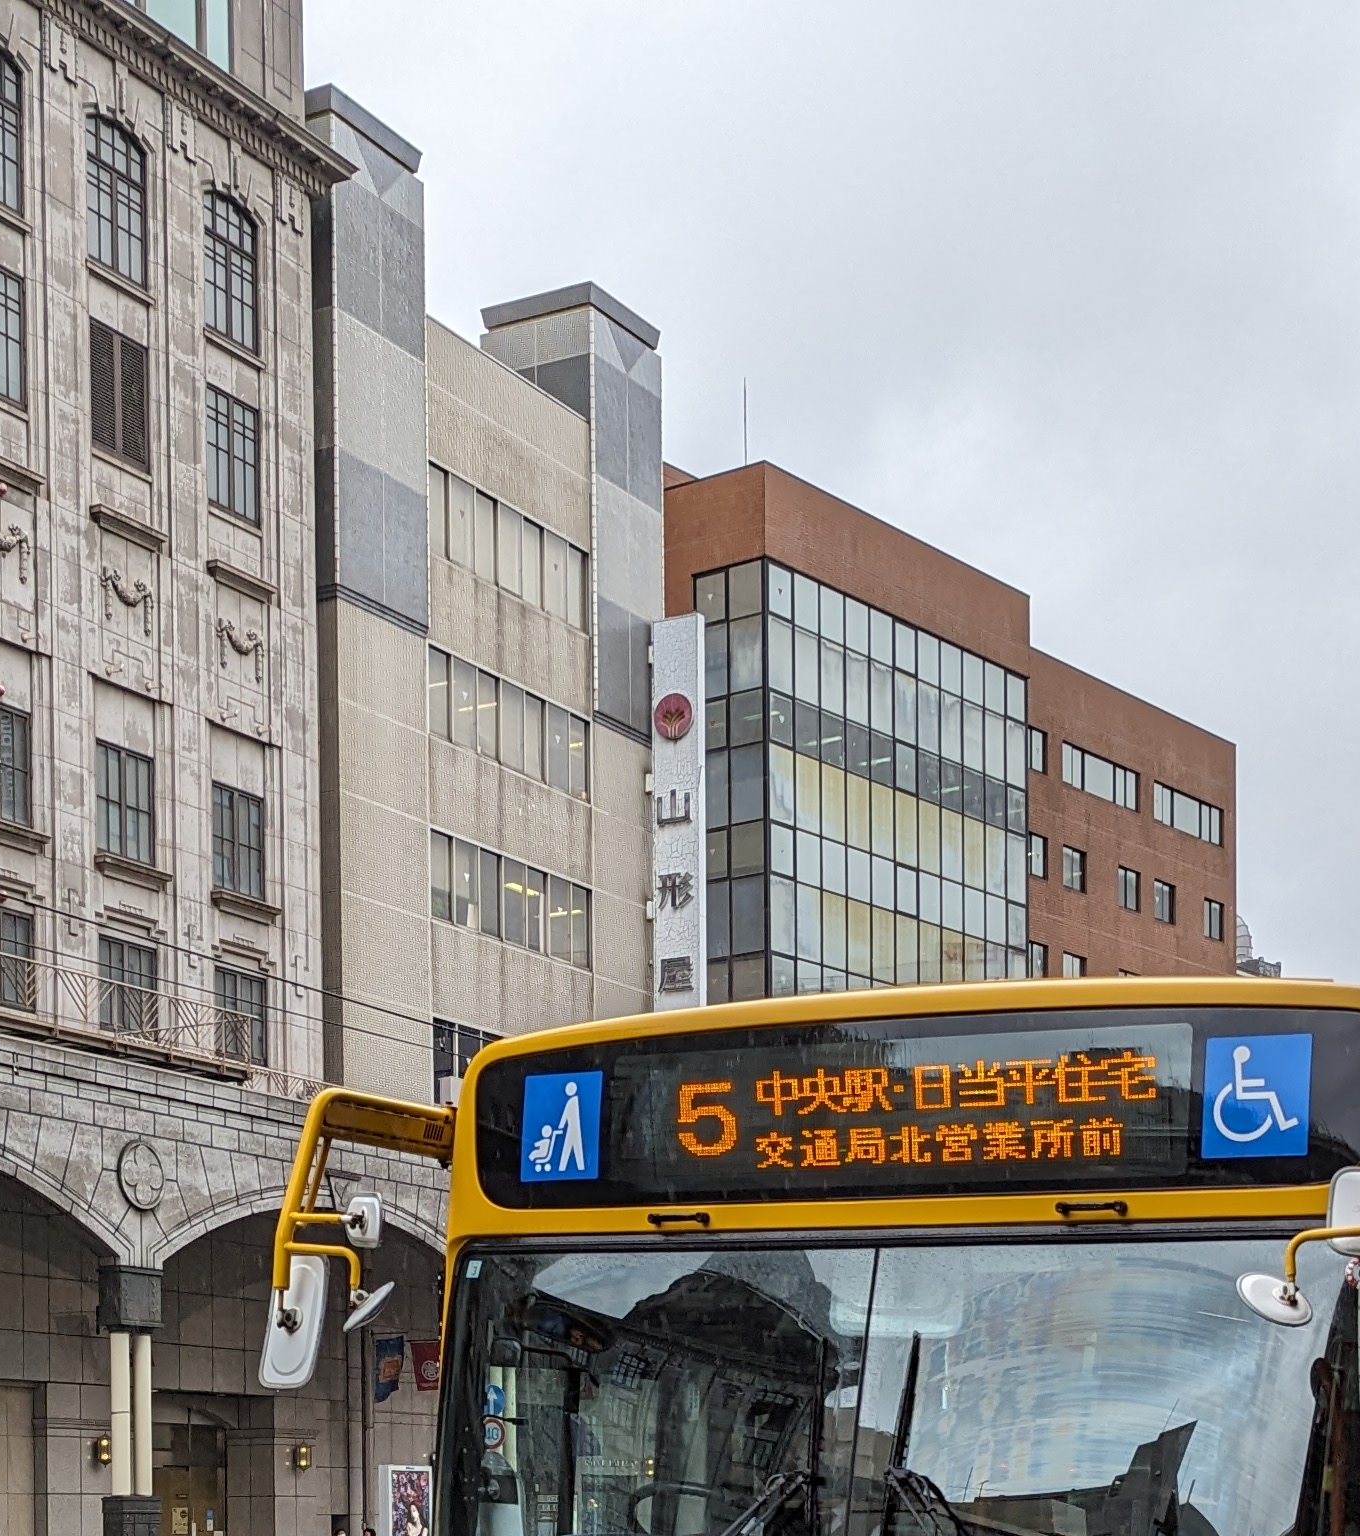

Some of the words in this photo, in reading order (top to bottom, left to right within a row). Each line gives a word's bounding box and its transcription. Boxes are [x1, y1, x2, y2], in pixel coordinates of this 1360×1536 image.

[656, 788, 694, 995] 山形屋
[677, 1082, 737, 1158] 5
[755, 1118, 1122, 1170] 交通局北営業所前
